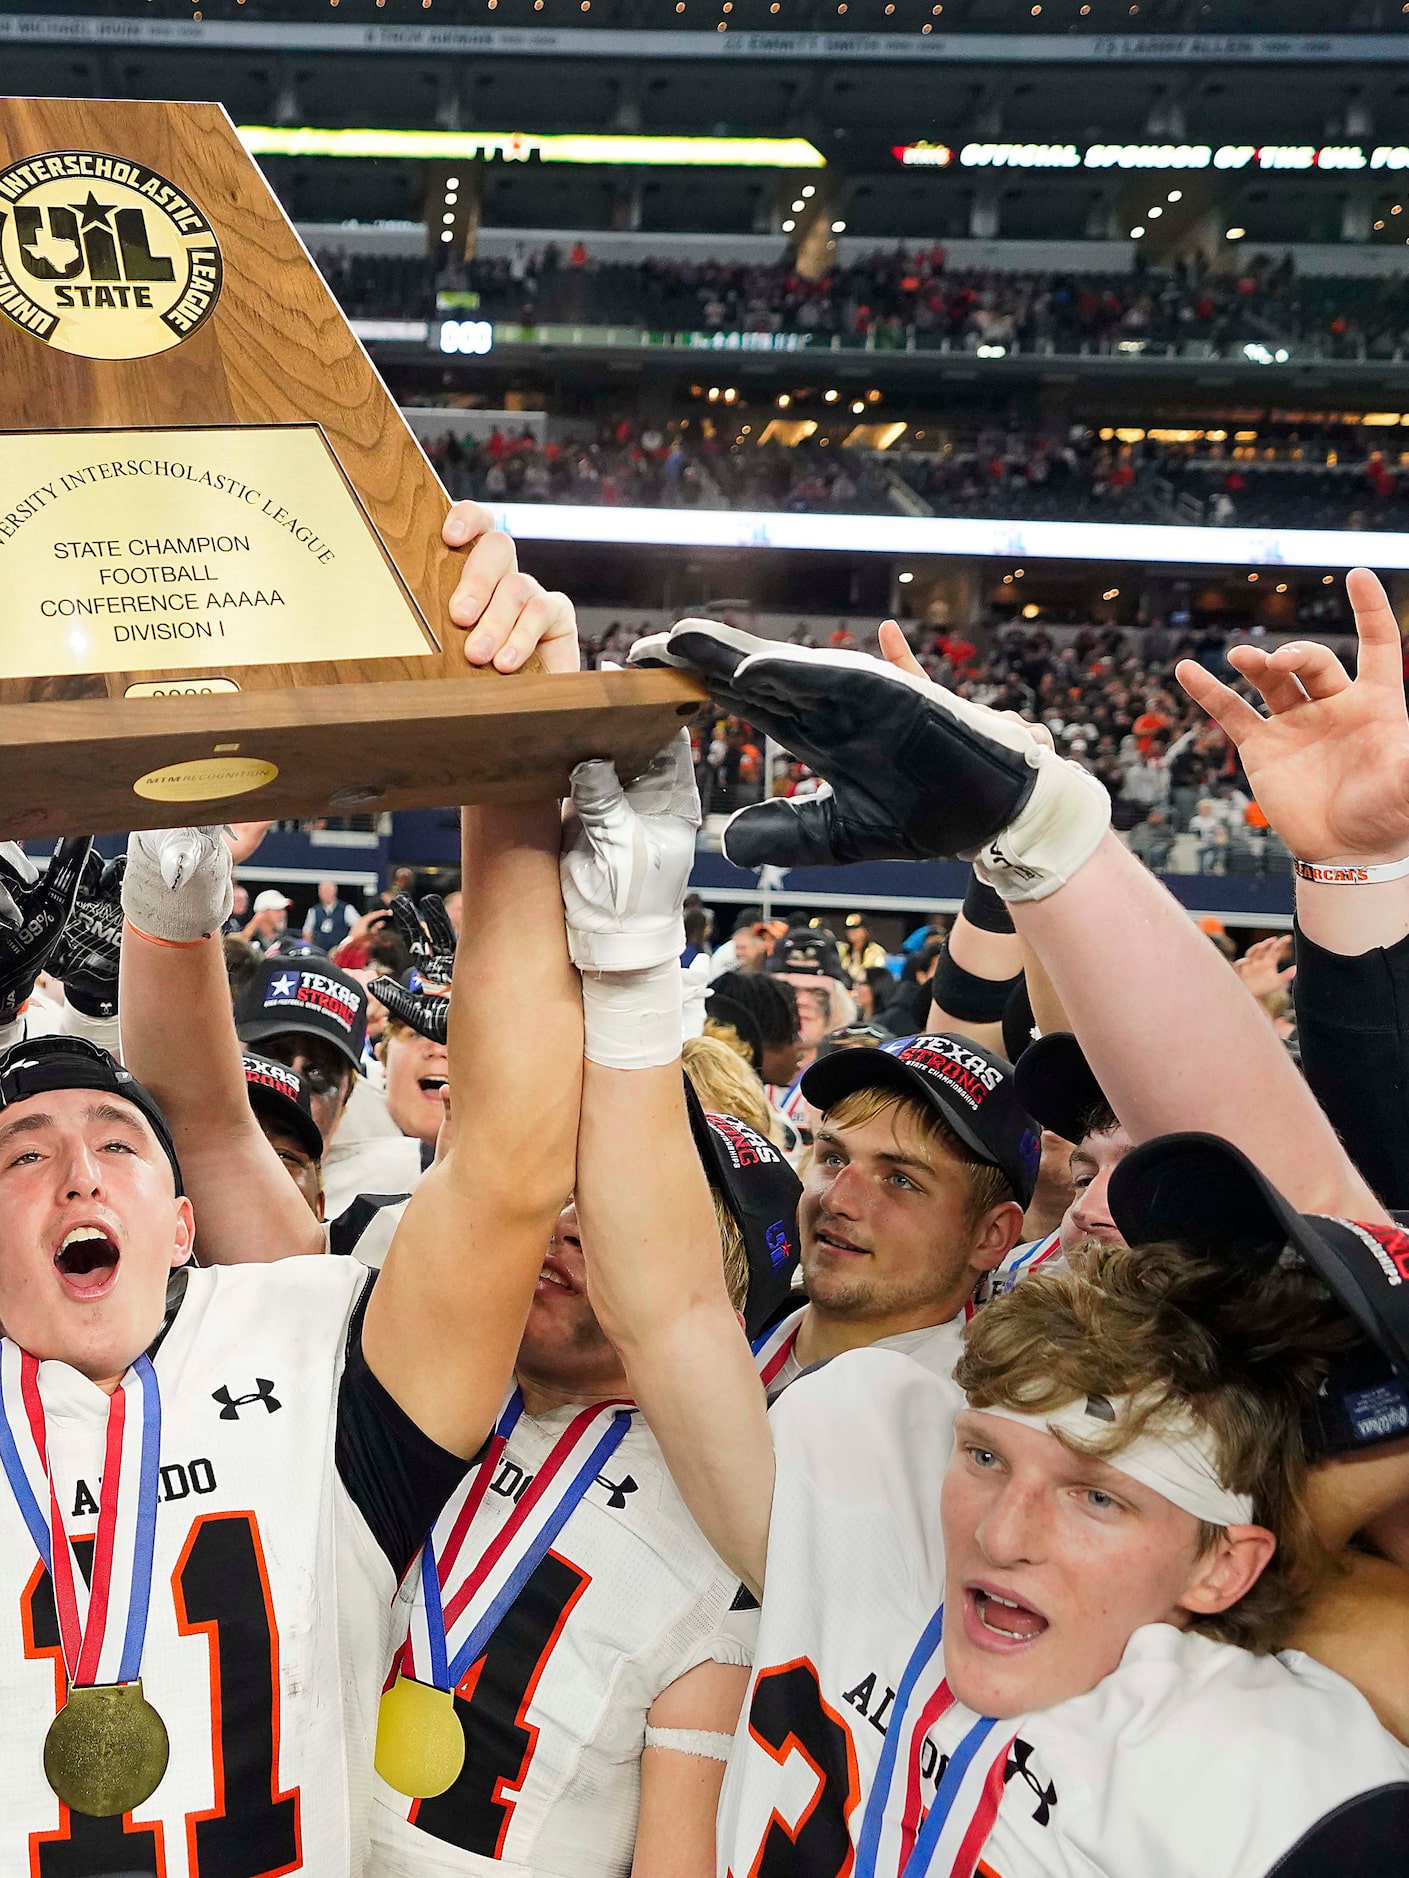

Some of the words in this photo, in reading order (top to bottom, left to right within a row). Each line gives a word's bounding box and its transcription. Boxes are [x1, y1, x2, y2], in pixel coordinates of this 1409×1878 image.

[53, 285, 154, 309] STATE
[167, 250, 217, 333] LEAGUE
[60, 458, 263, 505] INTERSCHOLASTIC
[261, 497, 336, 567] LEAGUE
[53, 540, 123, 560] STATE
[128, 535, 251, 558] CHAMPION
[98, 564, 219, 586] FOOTBALL
[40, 593, 199, 618] CONFERENCE
[205, 588, 286, 610] AAAAA
[113, 622, 214, 643] DIVISION
[218, 620, 225, 639] I
[296, 987, 355, 1026] STRONG
[301, 971, 361, 1013] TEXAS
[242, 1057, 300, 1093] EXAS
[898, 1048, 988, 1105] STRONG
[911, 1036, 1004, 1092] TEXAS
[245, 1071, 299, 1103] RONG
[928, 1067, 979, 1111] CHAMPIONSHIPS
[72, 1458, 217, 1517] ADO
